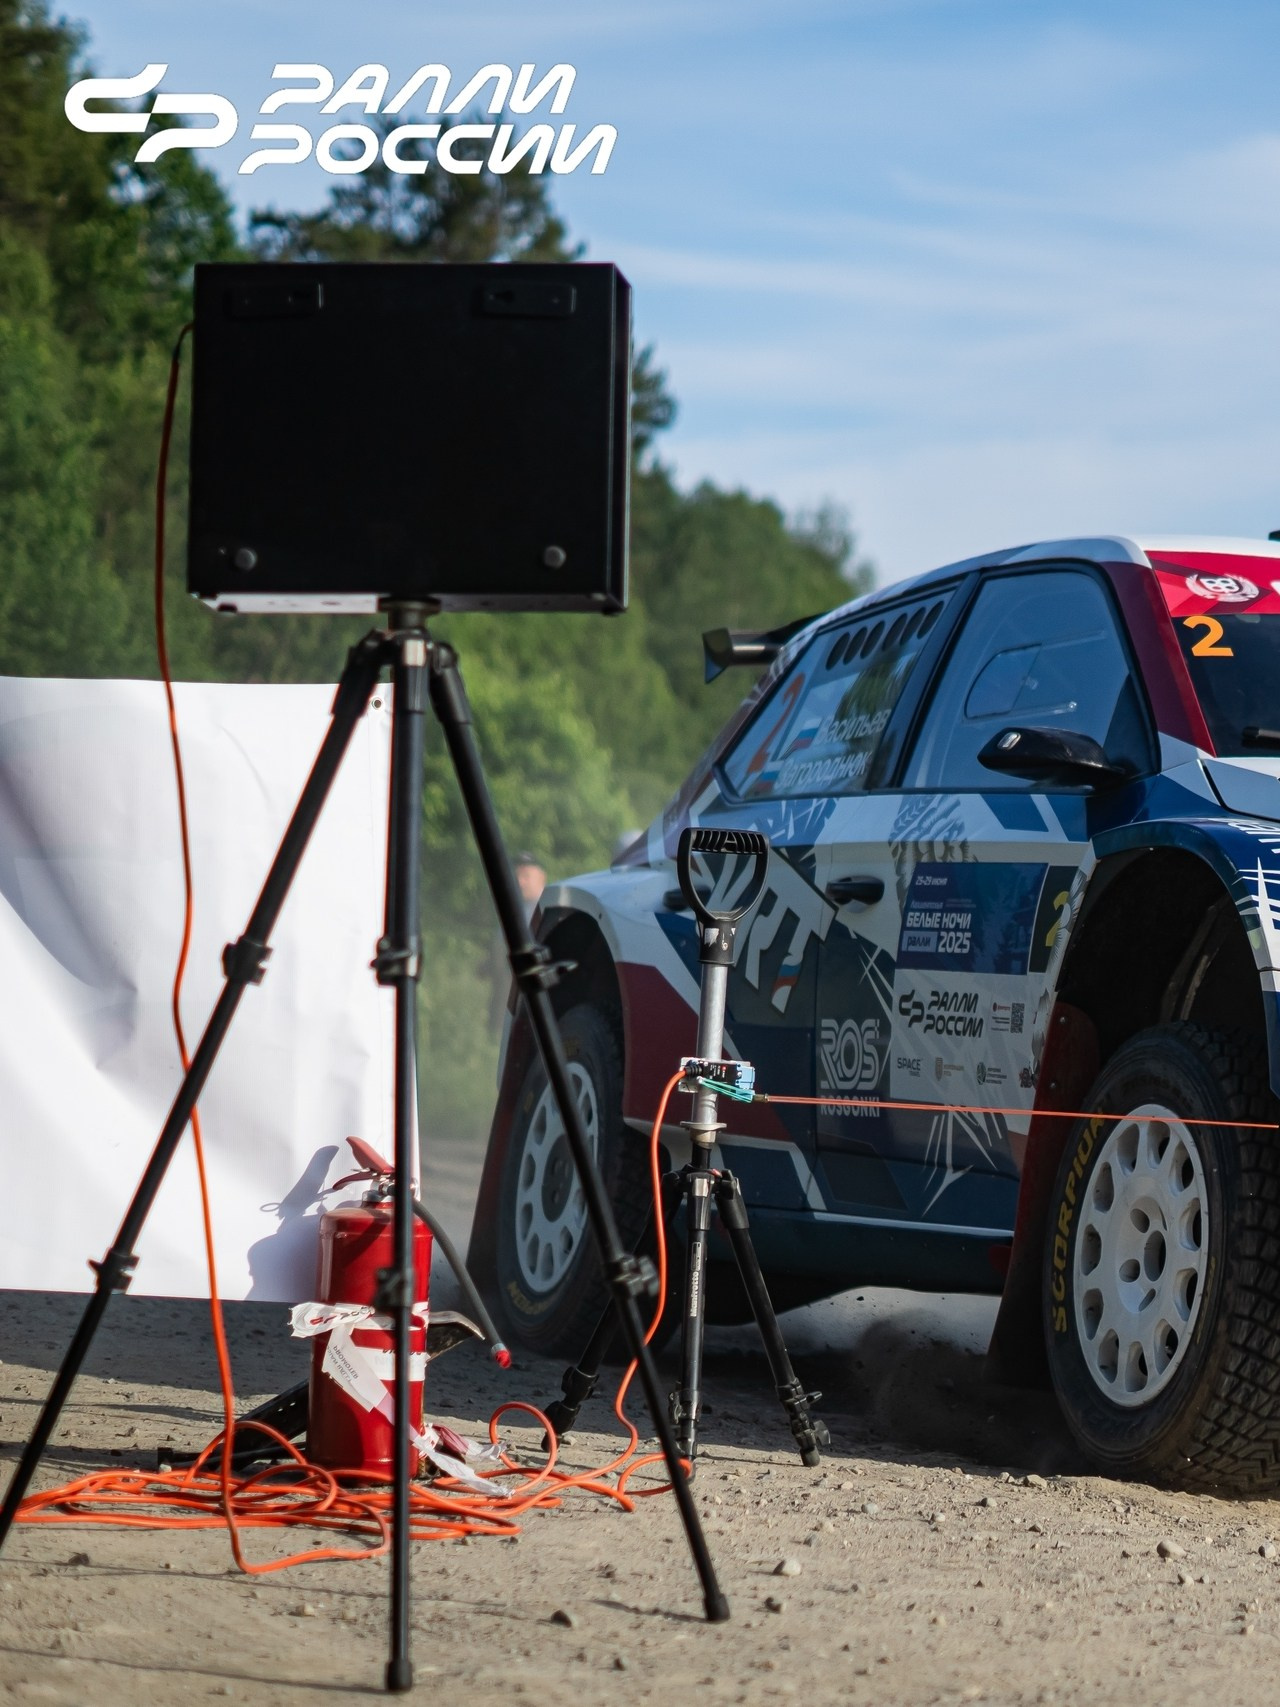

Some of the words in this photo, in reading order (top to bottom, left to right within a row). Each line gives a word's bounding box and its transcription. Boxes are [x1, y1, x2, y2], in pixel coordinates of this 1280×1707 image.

[1182, 615, 1234, 657] 2
[906, 911, 942, 929] БЕЛЫЕ
[941, 912, 972, 930] НОЧИ
[937, 931, 972, 954] 2025
[927, 990, 979, 1013] РАЛЛИ
[923, 1014, 984, 1038] РОССИИ
[820, 1018, 880, 1091] ROS
[897, 1057, 921, 1071] SPACE
[820, 1095, 880, 1117] ROSGONKI
